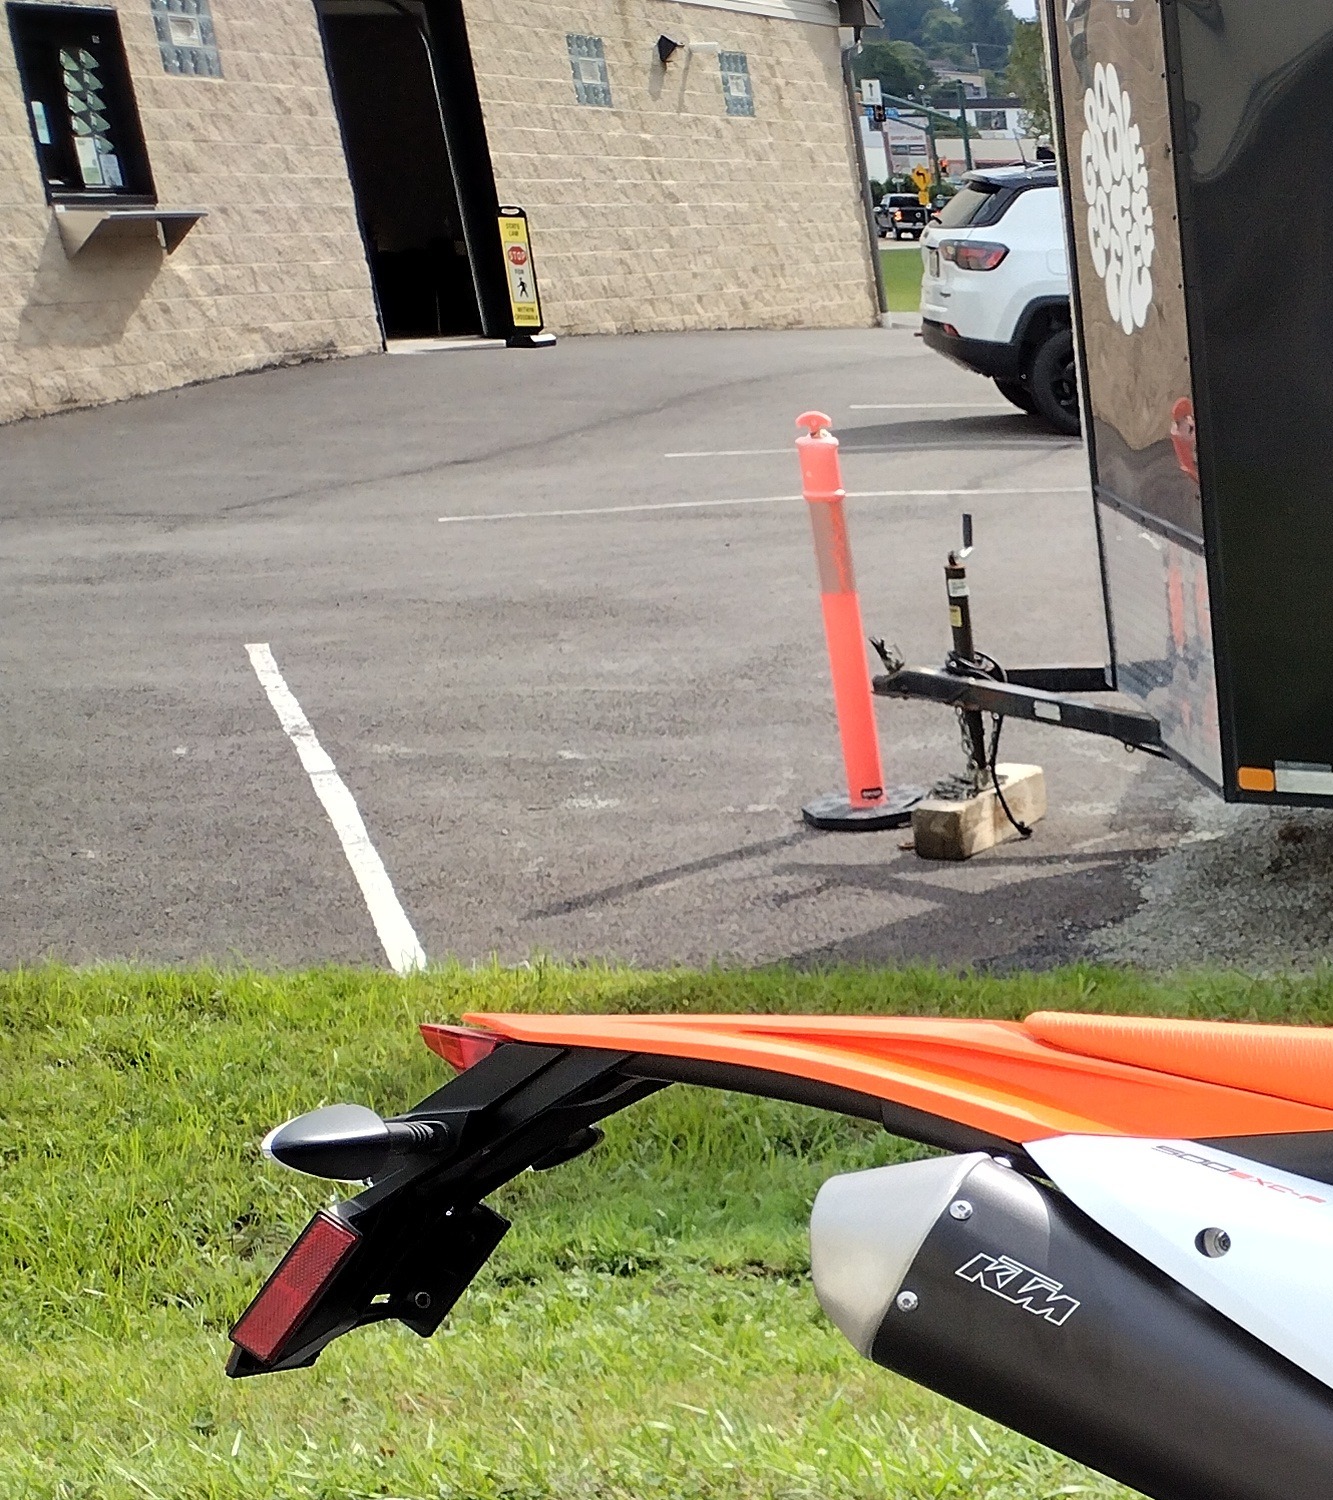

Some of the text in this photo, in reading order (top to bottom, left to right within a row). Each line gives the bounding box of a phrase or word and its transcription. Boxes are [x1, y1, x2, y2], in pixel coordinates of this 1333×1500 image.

[508, 250, 527, 261] STOP
[1087, 174, 1155, 336] COFFEE
[955, 1252, 1081, 1326] KTM
